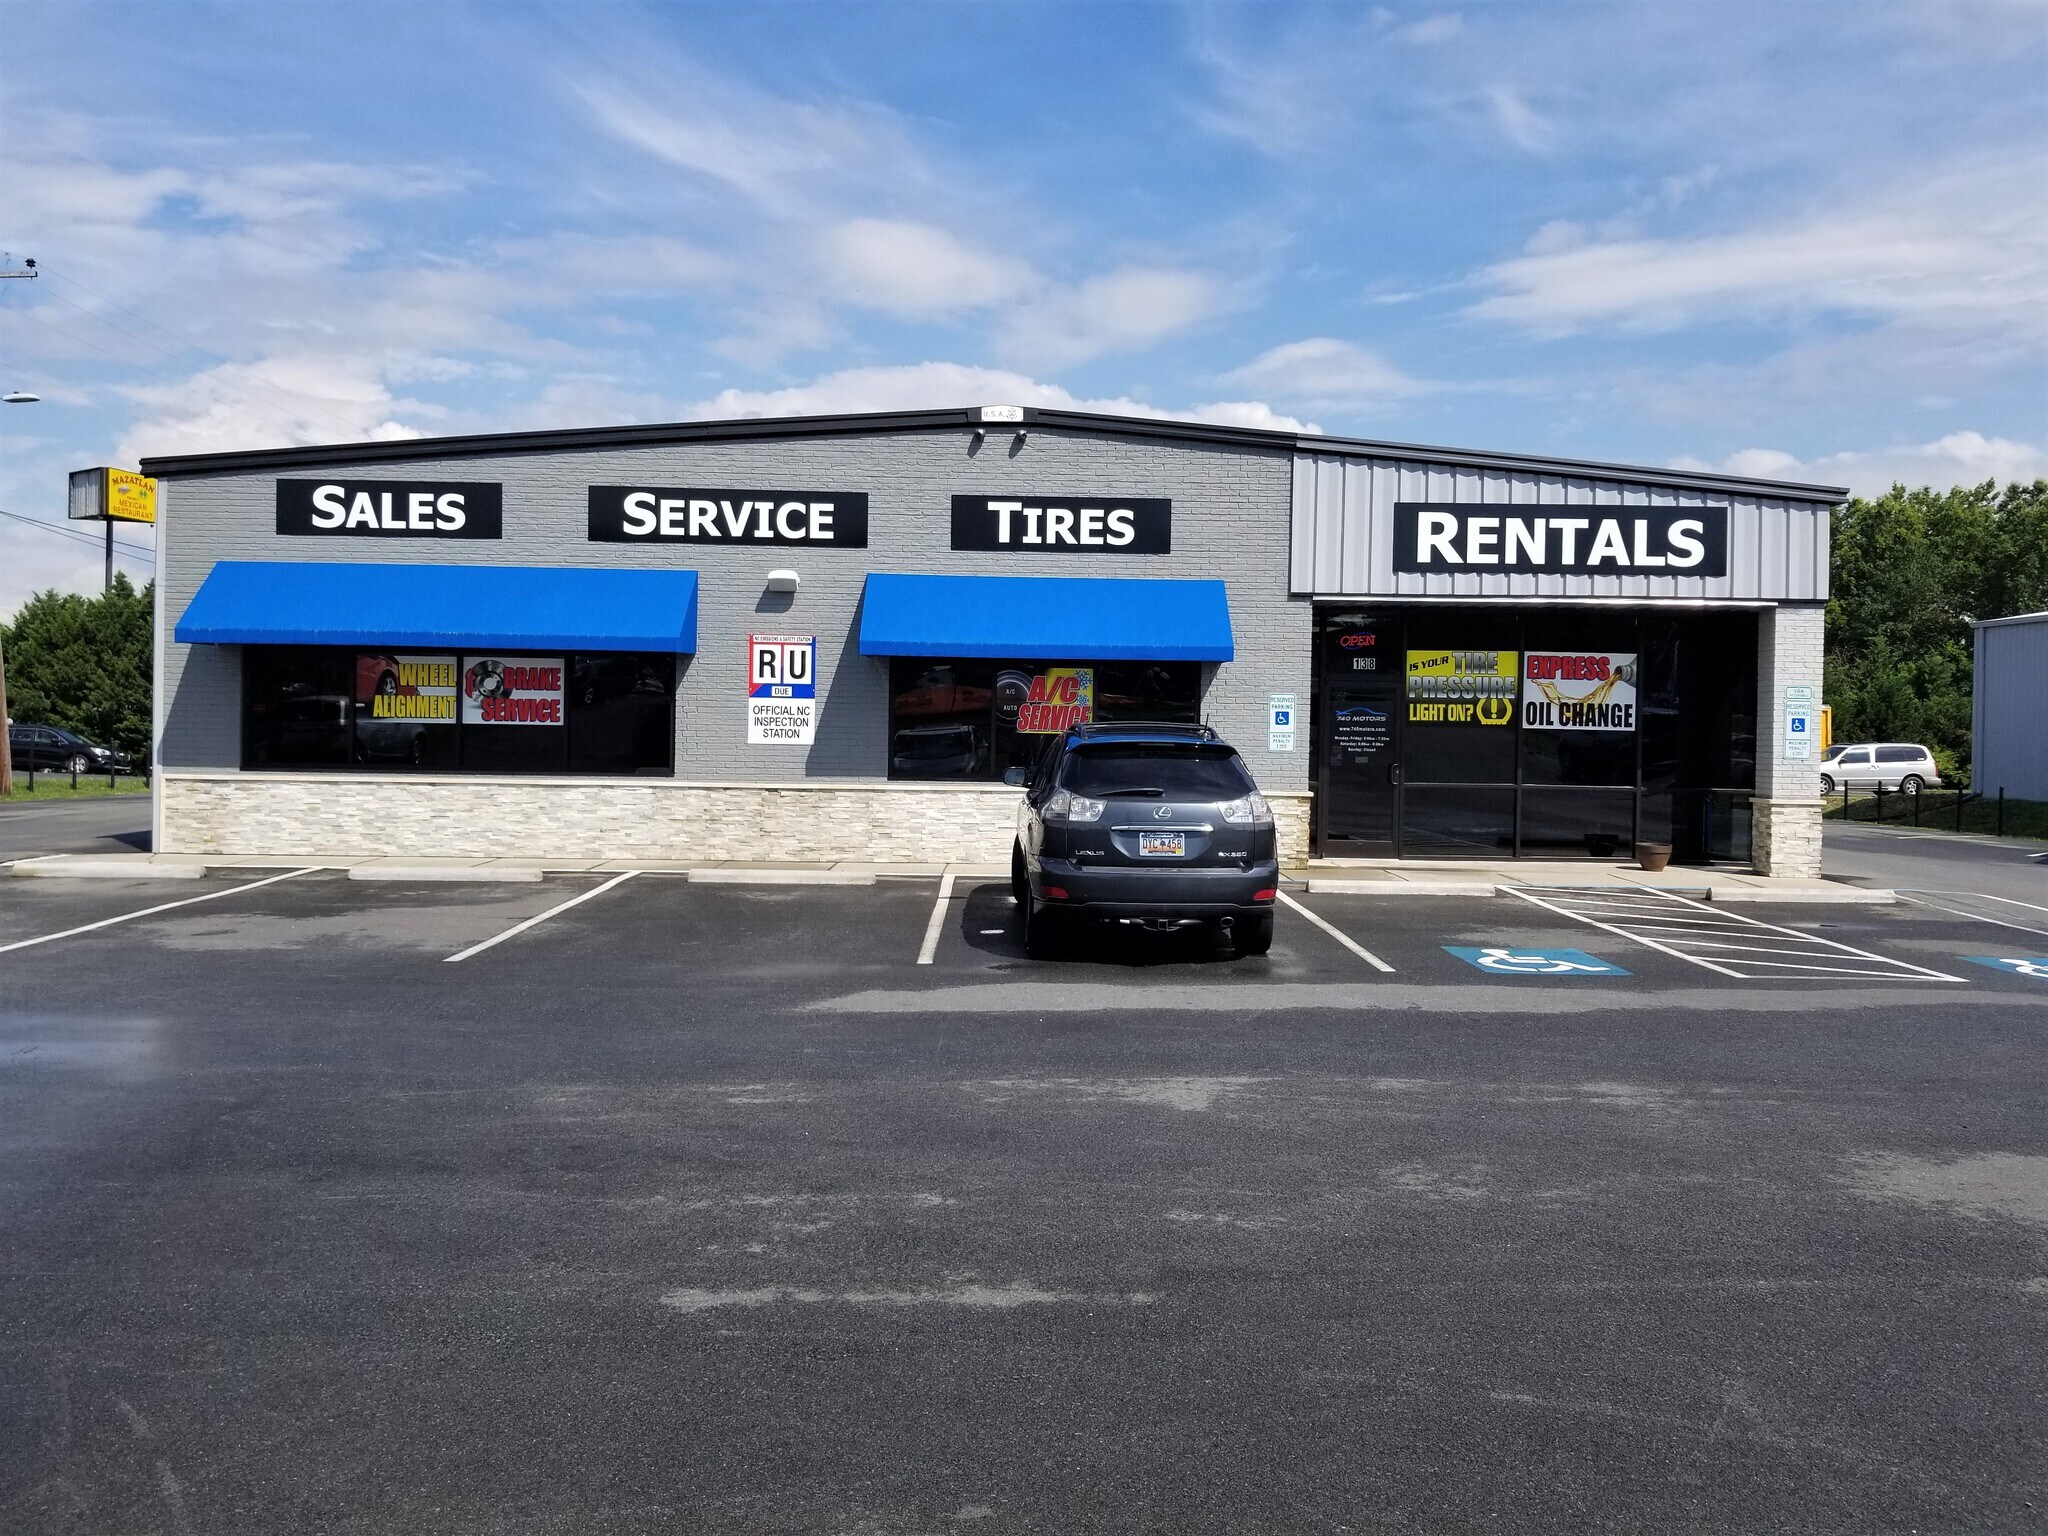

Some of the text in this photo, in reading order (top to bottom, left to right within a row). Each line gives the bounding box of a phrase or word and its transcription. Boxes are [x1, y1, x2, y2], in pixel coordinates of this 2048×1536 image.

[112, 475, 155, 494] MAZATLAN
[112, 505, 153, 519] RESTAURANT
[119, 499, 147, 511] MEXICAN
[1340, 634, 1376, 647] OPEN
[1354, 658, 1376, 670] 138
[1409, 651, 1499, 675] IS YOUR TIRE
[1527, 655, 1611, 681] EXPRESS
[399, 663, 456, 687] WHEEL
[504, 667, 561, 691] BRAKE
[774, 687, 790, 696] DUE
[1026, 675, 1080, 704] A/C
[1408, 675, 1516, 699] PRESSURE
[372, 694, 456, 718] ALIGNMENT
[481, 697, 561, 723] SERVICE
[752, 705, 811, 716] OFFICIAL NC
[1409, 703, 1474, 722] LIGHT ON?
[1525, 701, 1633, 728] OIL CHANGE
[754, 716, 809, 727] INSPECTION
[1017, 703, 1091, 732] SERVICE
[763, 728, 800, 739] STATION
[1142, 838, 1182, 849] DYC 458
